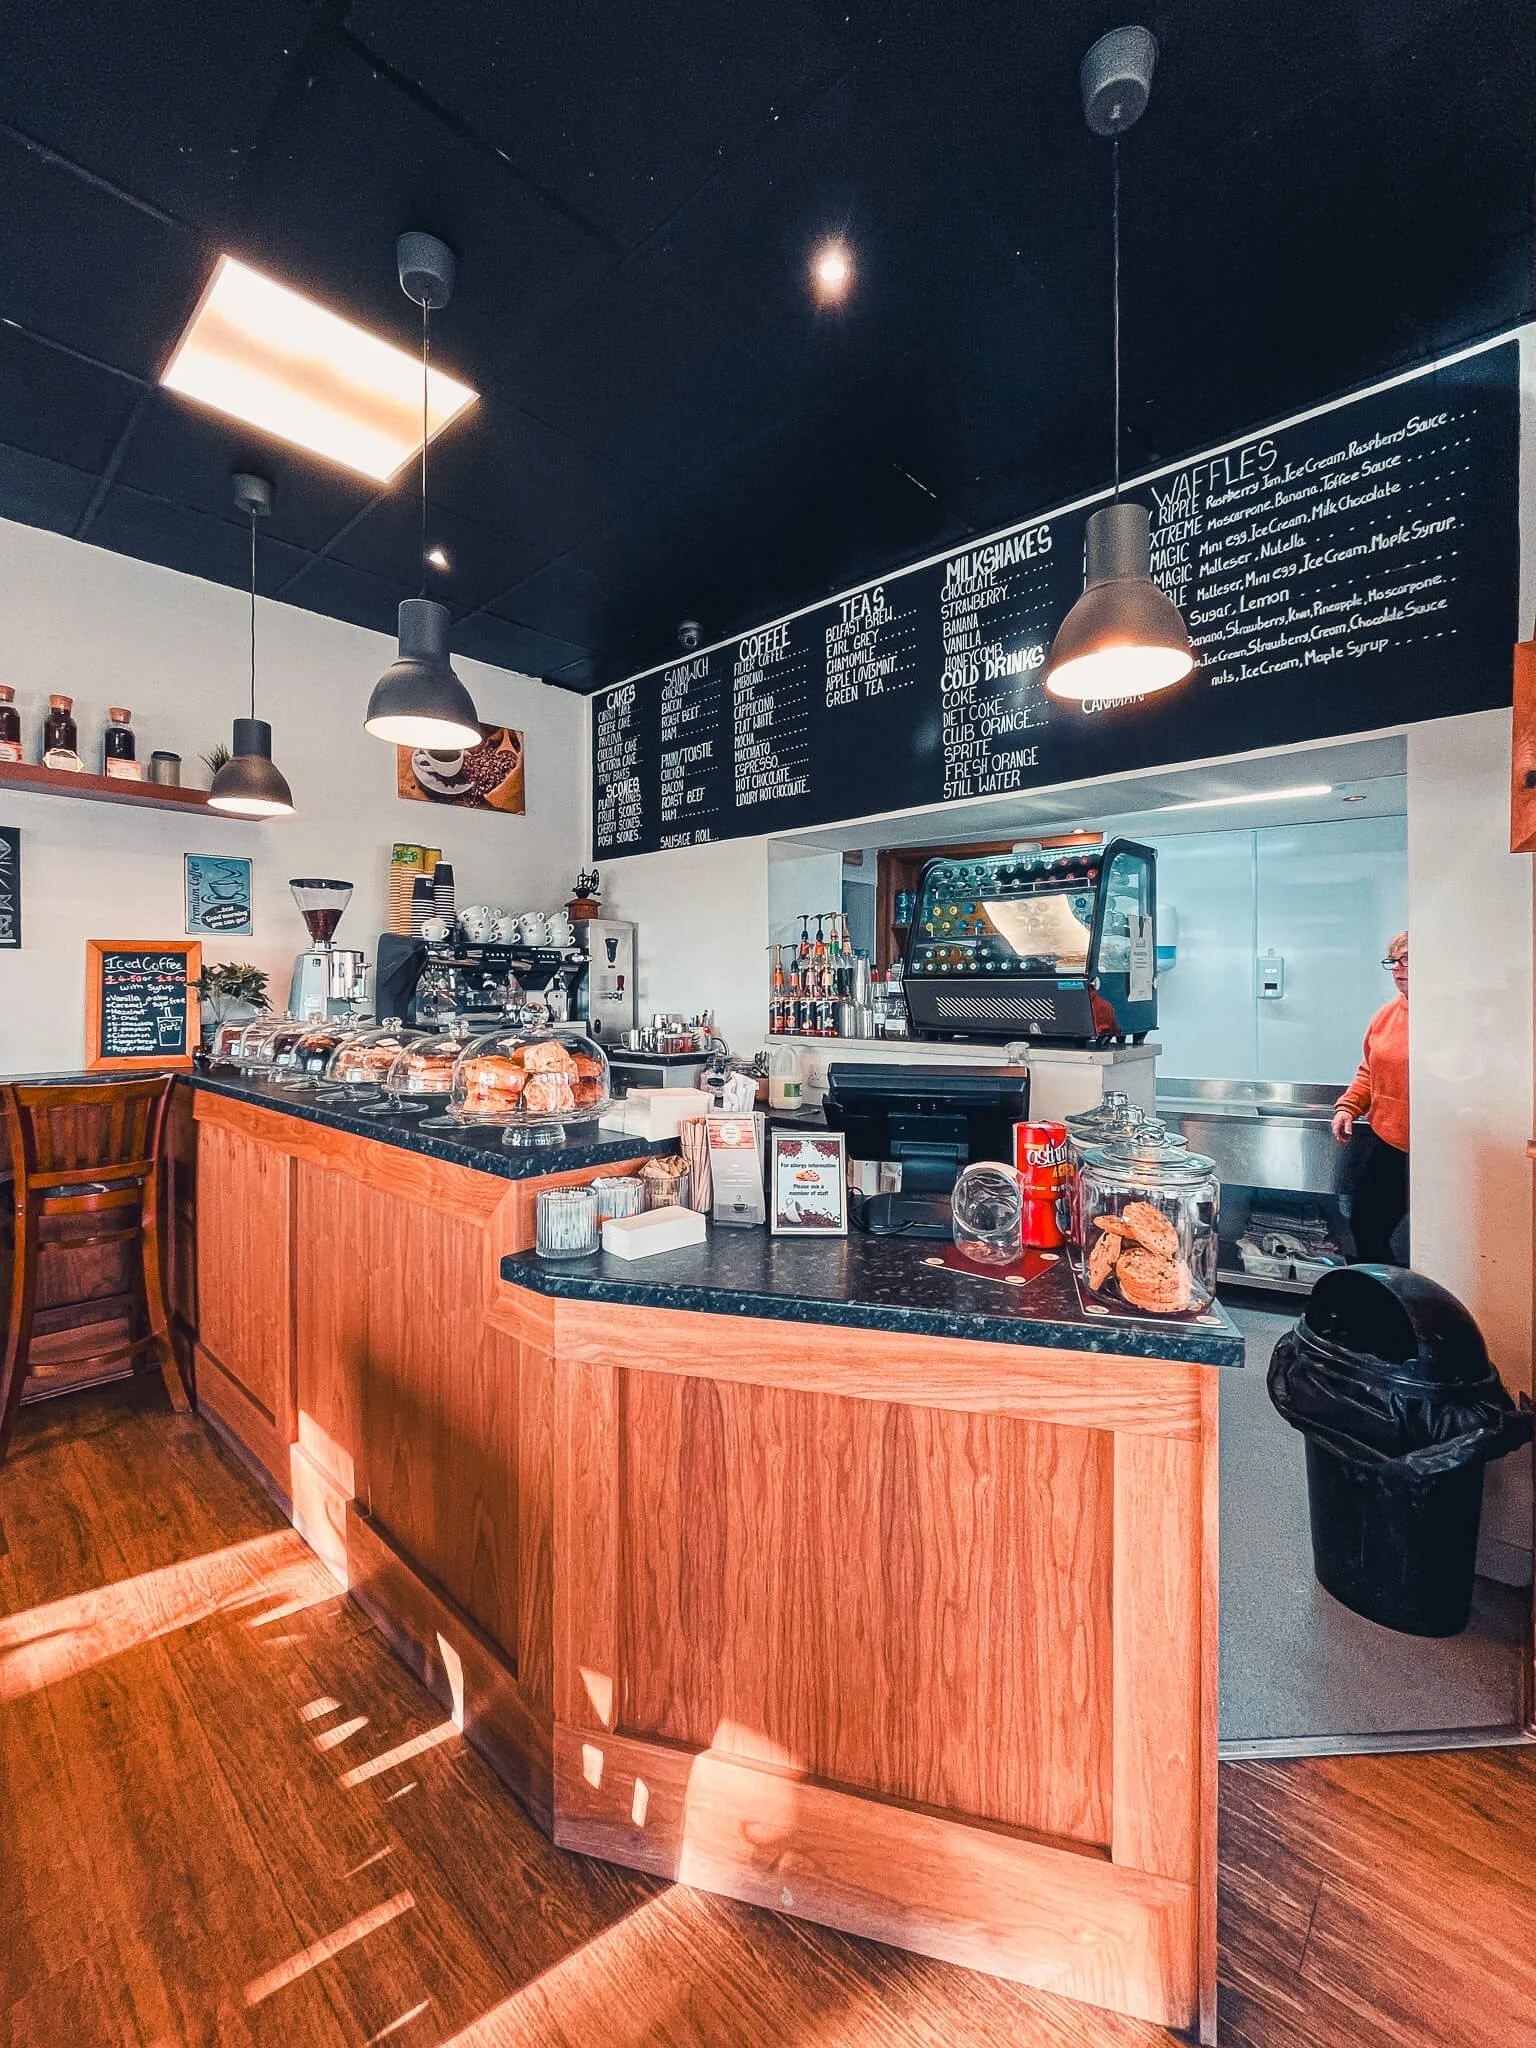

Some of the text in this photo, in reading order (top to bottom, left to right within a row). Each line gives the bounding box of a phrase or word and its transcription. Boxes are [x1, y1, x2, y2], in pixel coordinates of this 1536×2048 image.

[1151, 439, 1278, 507] WAFFLES
[1159, 494, 1199, 526] RIPPLE
[1205, 482, 1259, 510] Raspberry
[1406, 412, 1447, 437] Sauce
[1149, 514, 1204, 551] XTREME
[1320, 472, 1360, 492] Toffee
[1361, 455, 1402, 477] Sauce
[1150, 542, 1190, 573] MAGIC
[1199, 541, 1222, 557] Mini
[1311, 499, 1338, 521] Milk
[1338, 481, 1402, 511] Chocolate
[946, 525, 1053, 588] MILKSHAKES
[1153, 533, 1306, 589] MAGIC Nutella
[1245, 571, 1270, 588] Mini
[1371, 525, 1410, 552] Maple
[1411, 516, 1456, 540] Syrup
[940, 569, 998, 603] CHOCOLATE
[839, 586, 885, 623] TEAS
[941, 584, 1009, 620] STRAWBERRY
[1189, 589, 1290, 626] Sugar, Lemon
[1350, 606, 1404, 630] Chocolate
[1404, 598, 1448, 618] Sauce
[826, 605, 893, 644] BELFAST BREW
[942, 612, 979, 639] BANANA
[739, 622, 791, 662] COFFEE
[826, 628, 880, 660] EARL GREY
[942, 629, 981, 656] VANILLA
[1304, 646, 1343, 666] Maple
[1346, 638, 1388, 658] Syrup
[734, 646, 785, 676] FILTER COFFEE
[826, 645, 877, 675] CHAMOMILE
[940, 647, 1045, 693] COLD DRINKS
[944, 642, 1003, 673] HONEYCOMB
[664, 656, 709, 689] SANDWICH
[733, 669, 764, 691] AMERICANO
[826, 670, 851, 693] APPLE
[607, 684, 636, 709] CAKES
[661, 697, 682, 715] BACON
[733, 686, 755, 706] LATTE
[826, 677, 885, 708] GREEN TEA
[941, 686, 977, 710] COKE
[661, 705, 700, 729] ROAST BEEF
[734, 710, 774, 735] FLAT WHITE
[943, 698, 1004, 728] DIET COKE
[661, 726, 677, 742] HAM
[734, 732, 754, 749] MOCHA
[942, 709, 1032, 746] CLUB ORANGE
[944, 739, 992, 764] SPRITE
[945, 746, 1040, 782] FRESH ORANGE
[660, 765, 685, 782] CHICKEN
[734, 755, 778, 778] ESPRESSO
[735, 767, 790, 792] HOT CHOCOLATE
[606, 777, 640, 798] SCONES
[661, 779, 684, 796] BACON
[661, 787, 705, 809] ROAST BEEF
[736, 778, 806, 807] LUXURY HOT CHOCOLATE
[943, 770, 1021, 800] STILL WATER
[598, 798, 615, 811] PLAIN
[598, 808, 615, 823] FRUIT
[661, 808, 677, 821] HAM
[598, 834, 612, 848] POSH
[660, 828, 711, 848] SAUSAGE ROLL
[189, 861, 202, 925] Premium Coffee
[104, 956, 183, 971] Iced Coffee
[147, 984, 175, 993] Syrup
